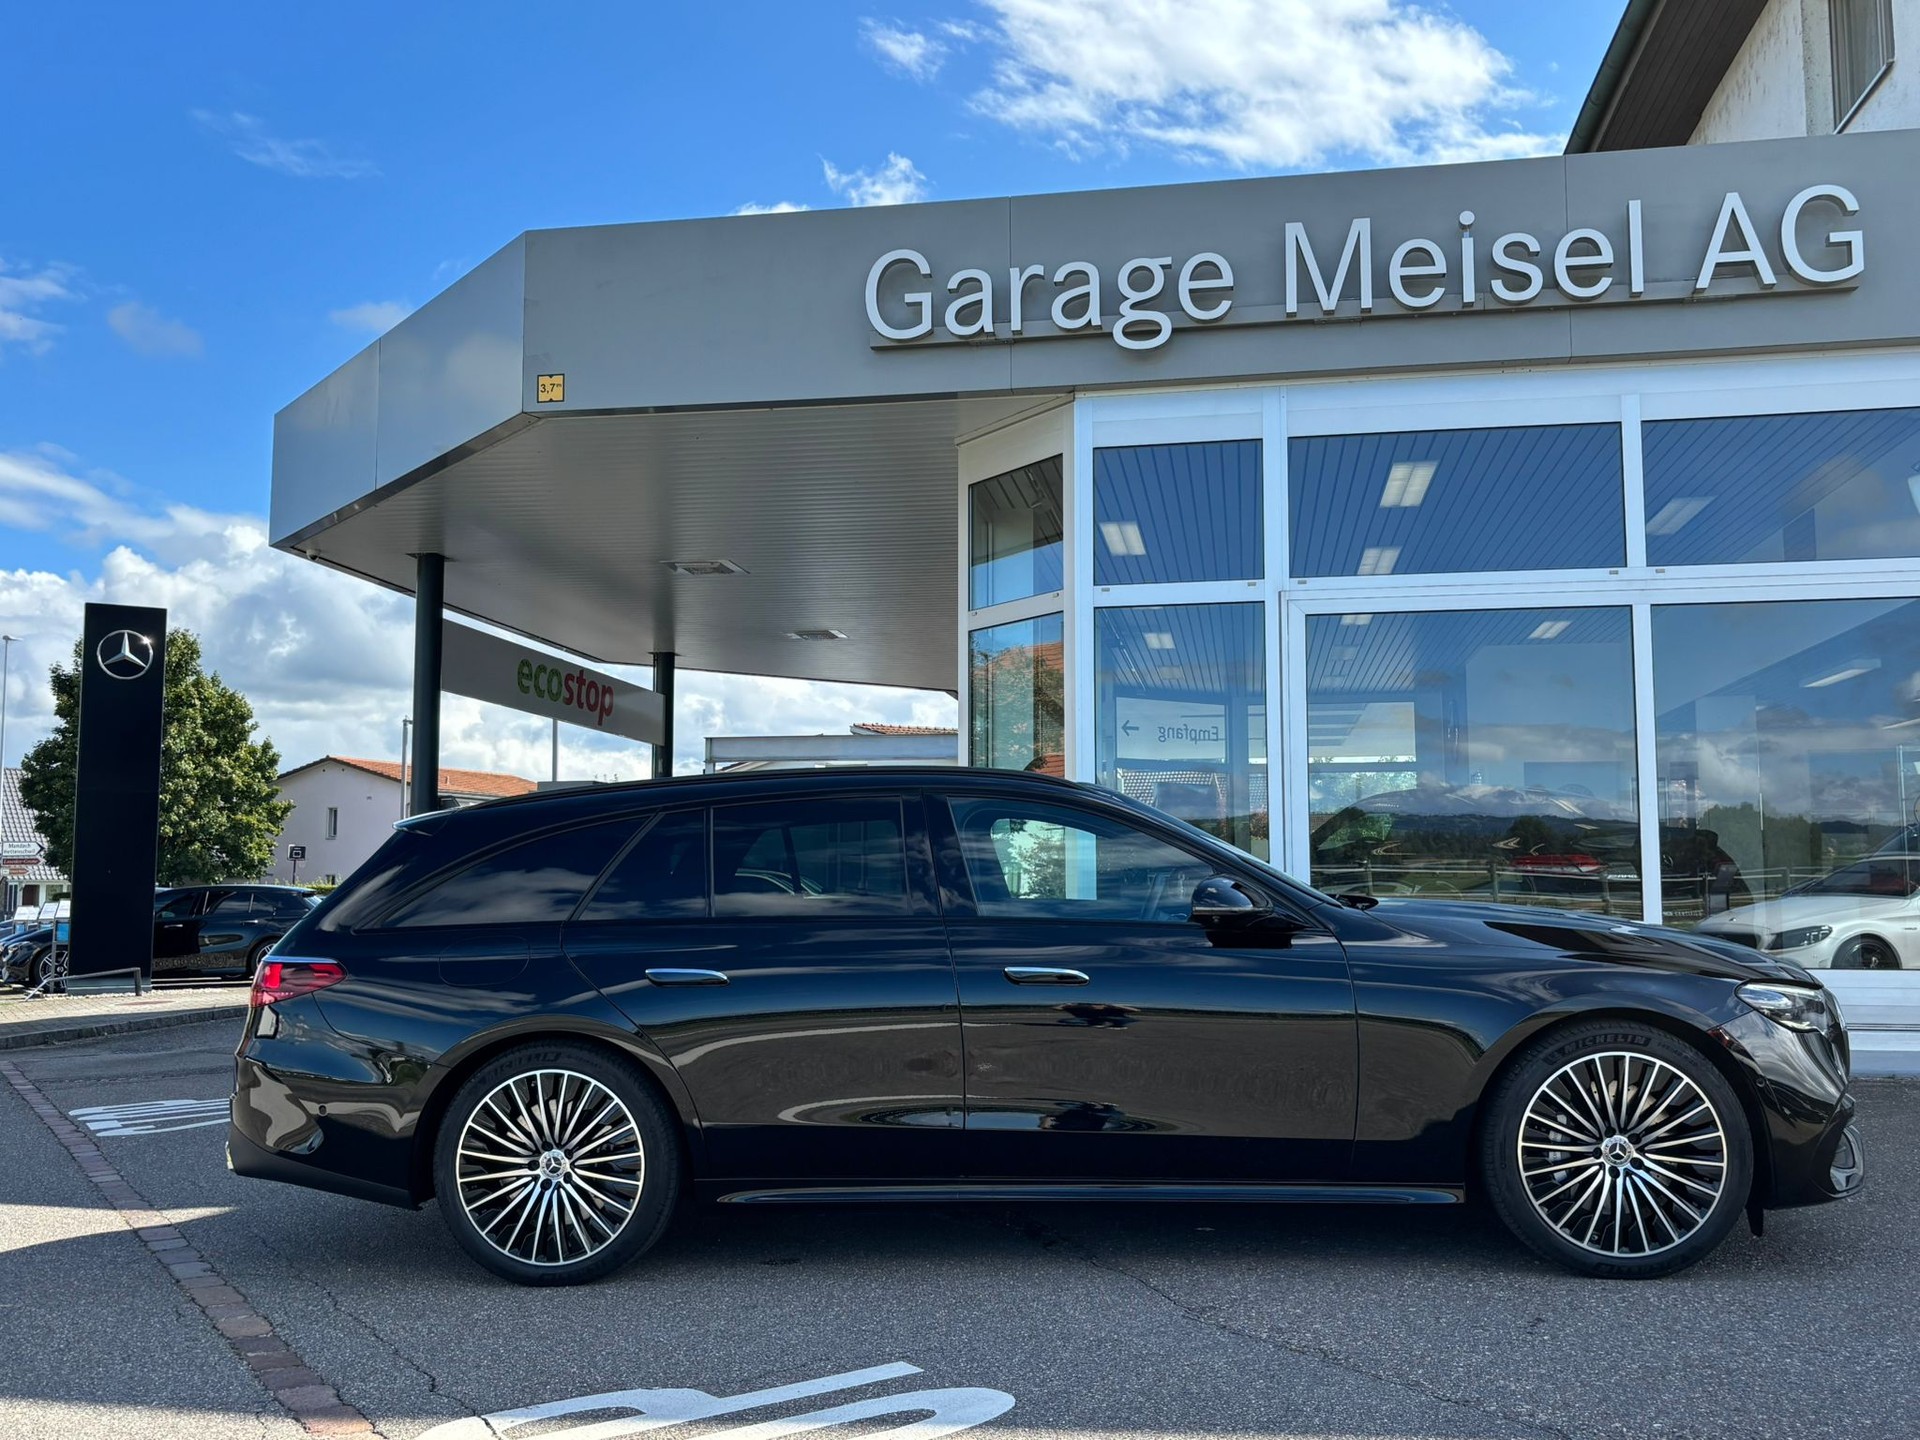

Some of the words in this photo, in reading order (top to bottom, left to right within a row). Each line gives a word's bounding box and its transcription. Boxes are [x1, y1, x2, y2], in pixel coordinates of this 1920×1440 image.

[865, 248, 1234, 350] Garage
[1285, 199, 1644, 317] Meisel
[1695, 184, 1865, 292] AG
[517, 659, 614, 726] ecostop
[1563, 1034, 1646, 1055] MICHELIN
